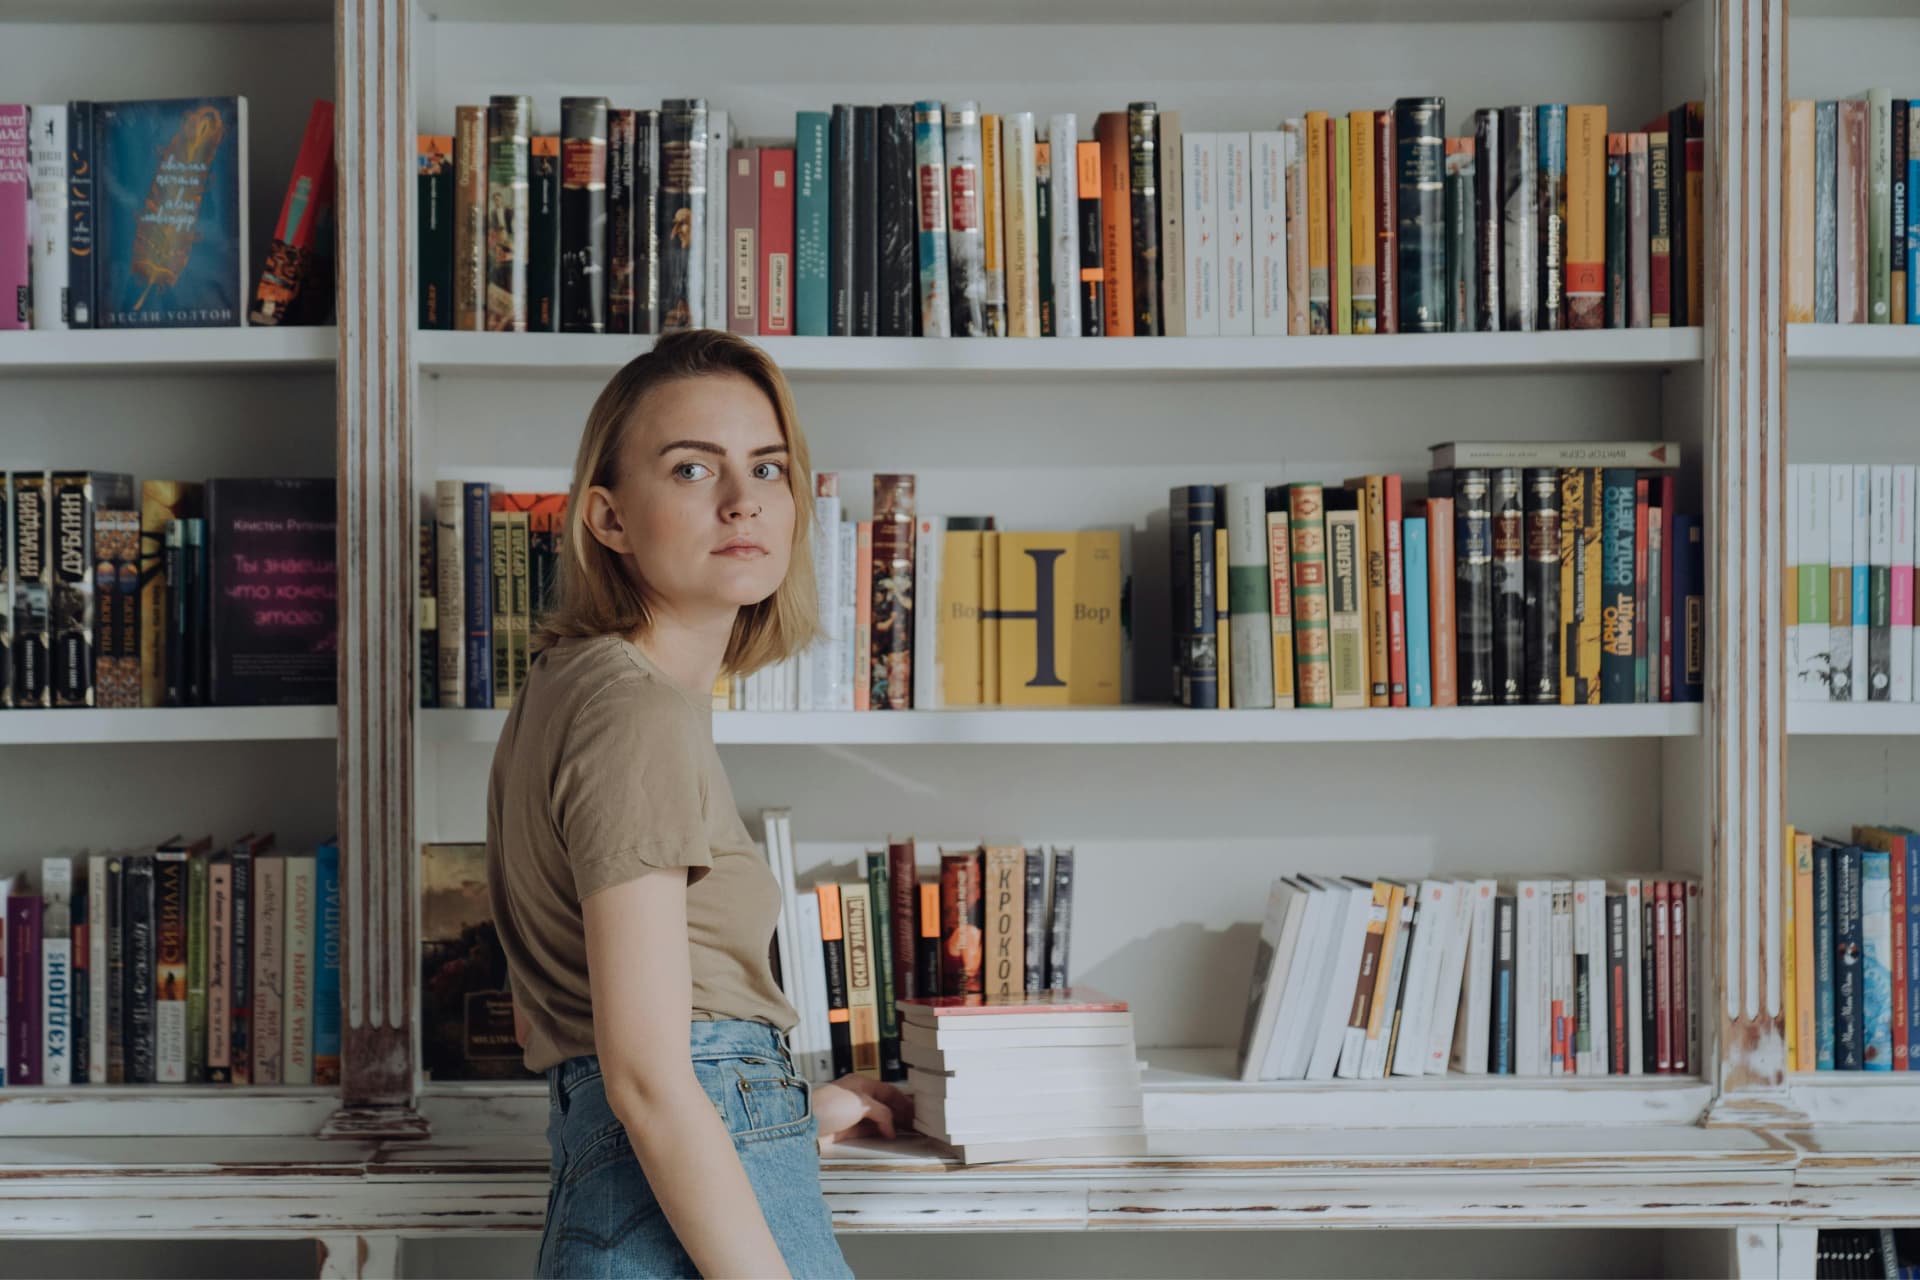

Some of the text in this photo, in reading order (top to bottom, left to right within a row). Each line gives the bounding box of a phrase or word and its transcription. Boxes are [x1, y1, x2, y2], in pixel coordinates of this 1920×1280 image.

[1653, 148, 1667, 190] МОЭМ
[1894, 182, 1905, 237] МИНГЮ
[167, 309, 232, 322] УОЛТОН
[19, 492, 42, 577] ИРЛАНДИЯ
[61, 493, 83, 575] ДУБЛИН
[1272, 527, 1289, 581] ХАКСЛИ
[1336, 524, 1353, 577] ХЕЛЛЕР
[1618, 486, 1634, 585] ОТЦА ДЕТИ
[234, 554, 258, 573] Ты
[253, 610, 324, 626] этого
[275, 584, 337, 600] хочеш
[1603, 606, 1618, 655] АРНО
[1617, 592, 1635, 656] ШМИДТ
[324, 879, 341, 969] КОМПАС
[998, 869, 1012, 1001] КРОКОД
[852, 948, 868, 987] ОСКАР
[48, 963, 68, 1058] ХЭДДОН
